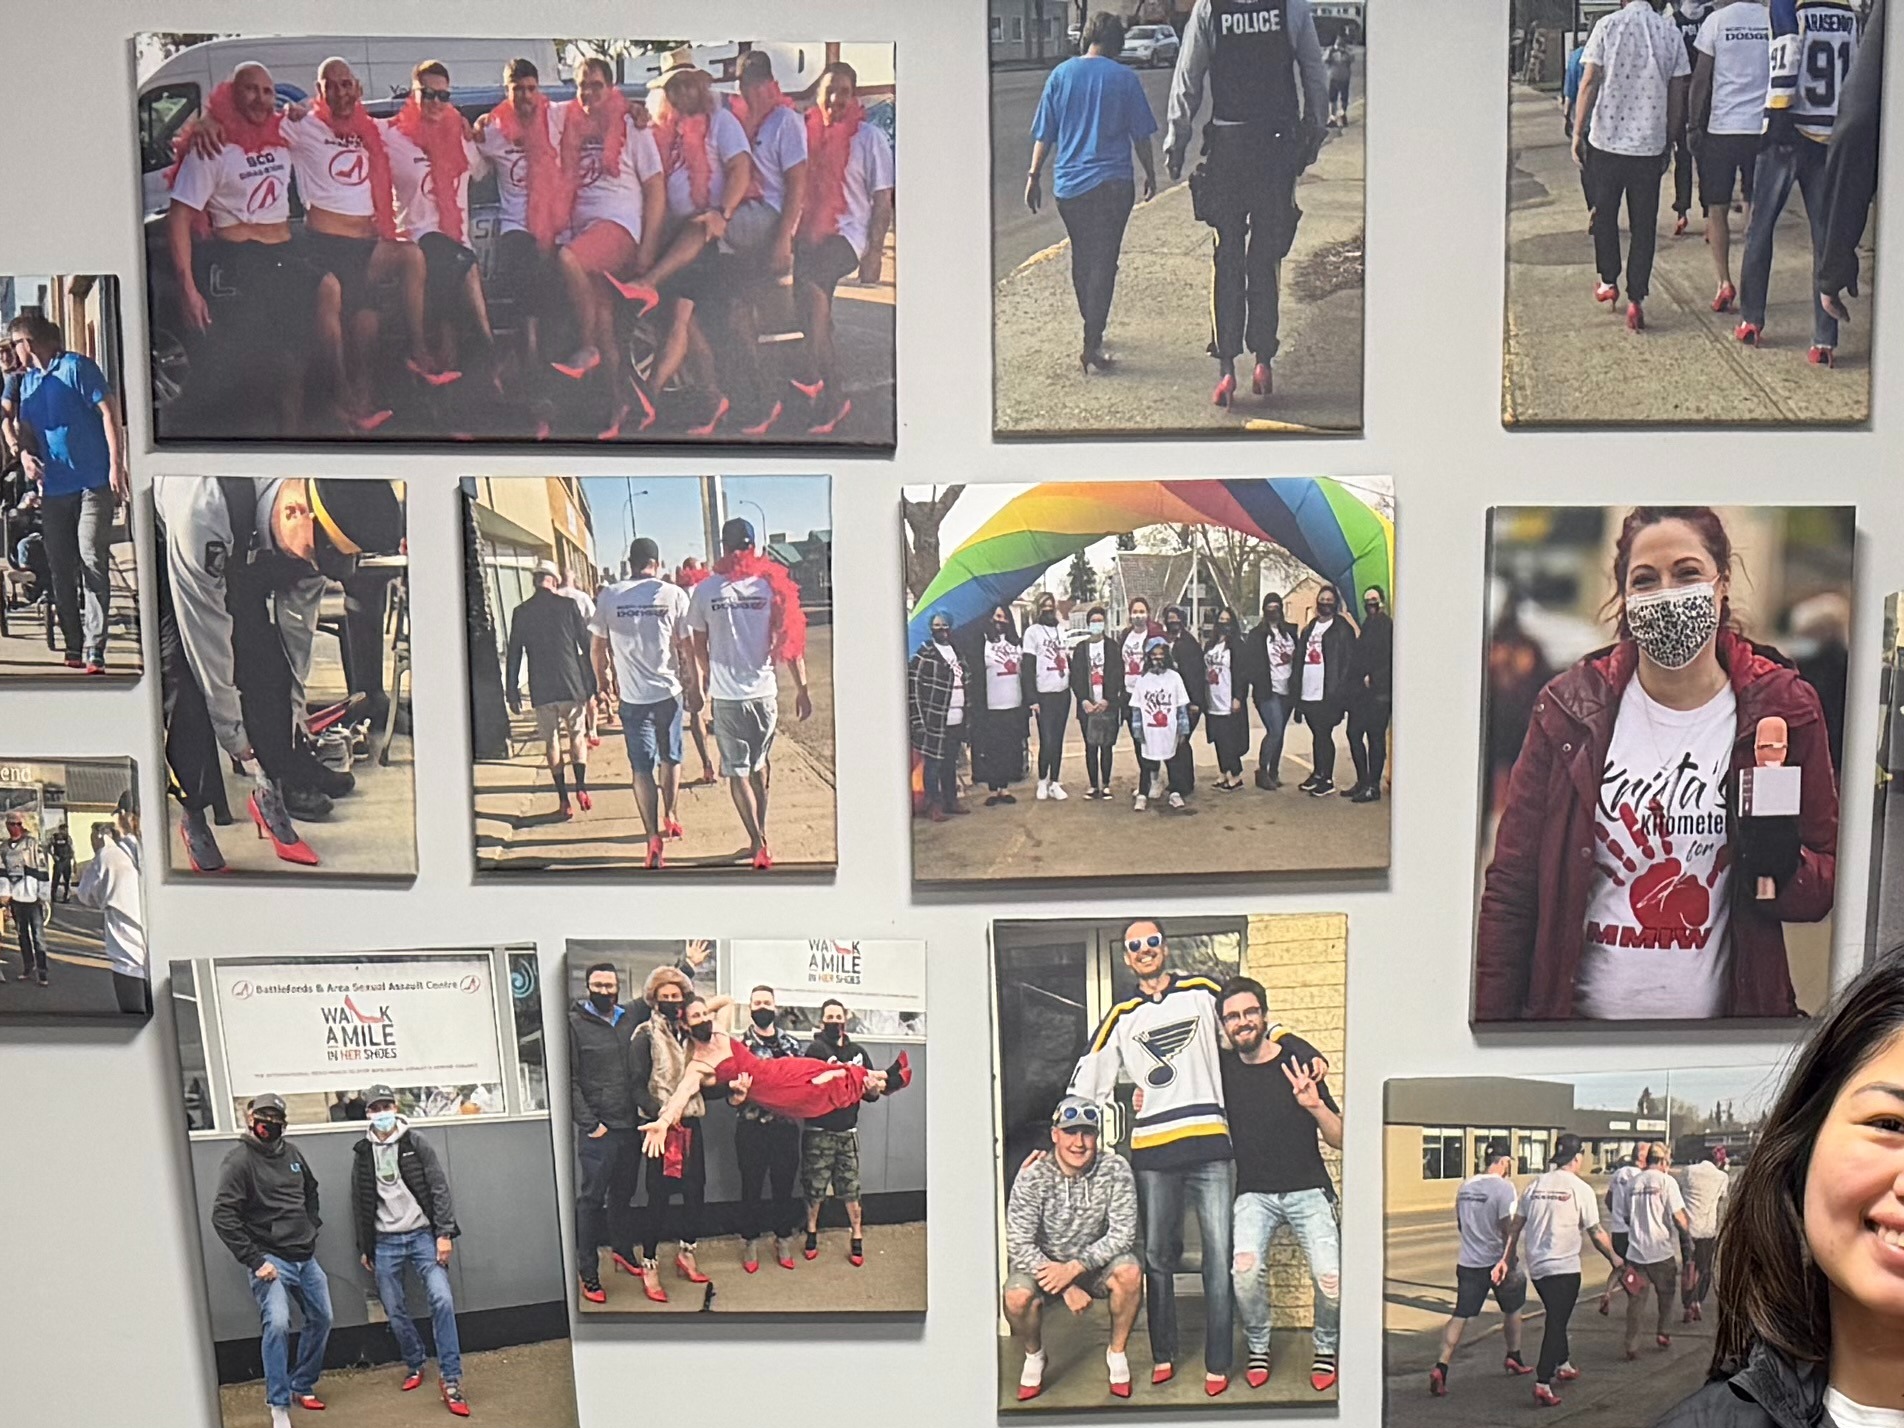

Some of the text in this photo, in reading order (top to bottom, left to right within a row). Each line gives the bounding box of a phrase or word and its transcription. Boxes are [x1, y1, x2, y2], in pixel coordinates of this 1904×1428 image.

[1222, 9, 1280, 34] POLICE
[1771, 44, 1787, 71] 91
[1805, 40, 1850, 107] 91
[1686, 840, 1714, 862] for
[1586, 921, 1712, 949] MMIW
[809, 954, 861, 974] A MILE
[256, 984, 313, 995] Battlefords
[327, 983, 350, 993] Area
[353, 982, 386, 992] Sexual
[389, 981, 423, 991] Assault
[426, 981, 458, 991] Centre
[808, 974, 816, 982] IN
[818, 974, 834, 983] HER
[326, 1024, 396, 1047] A MILE
[327, 1048, 397, 1061] IN HER SHOES
